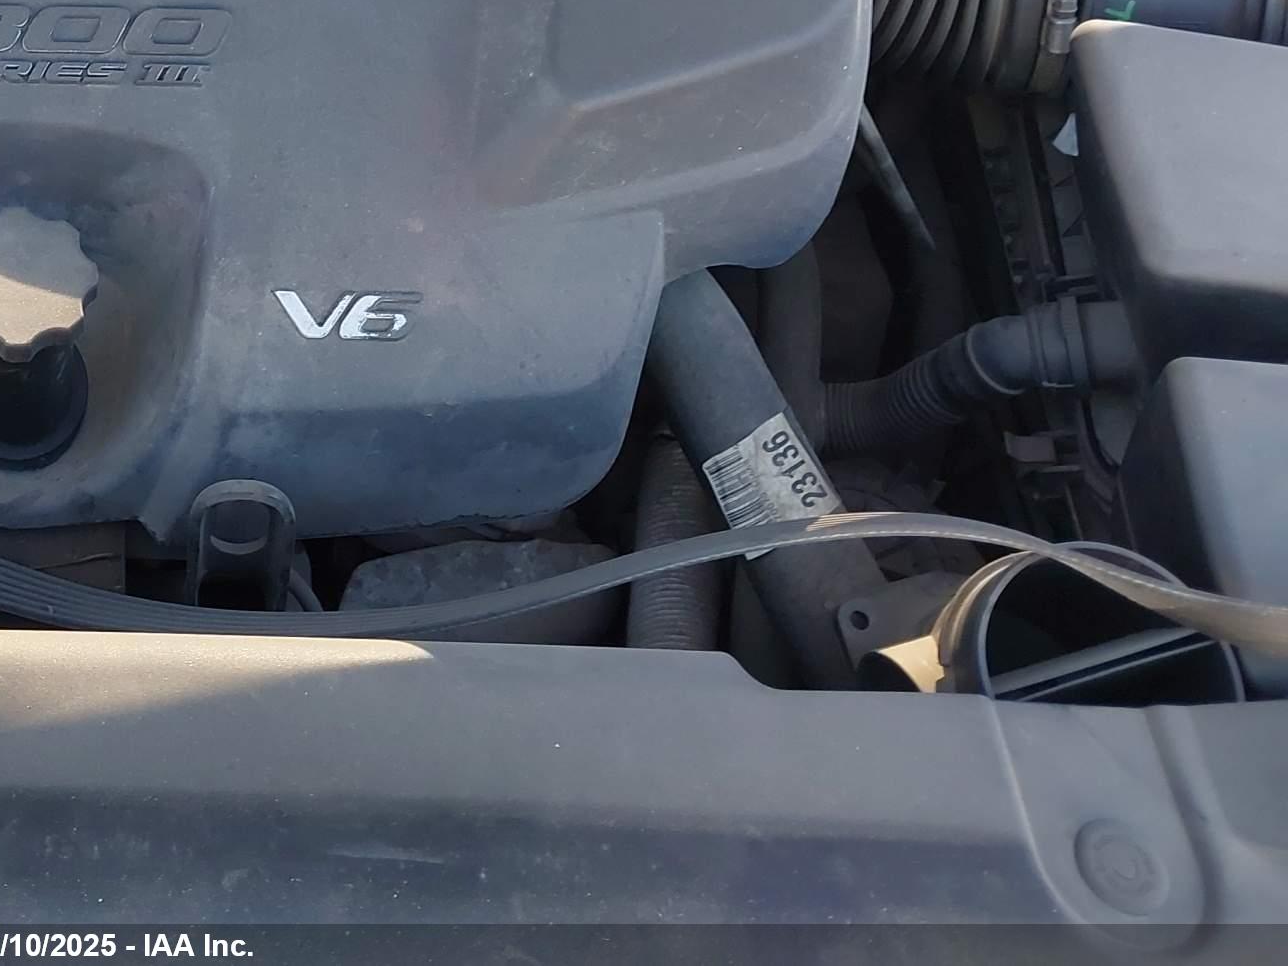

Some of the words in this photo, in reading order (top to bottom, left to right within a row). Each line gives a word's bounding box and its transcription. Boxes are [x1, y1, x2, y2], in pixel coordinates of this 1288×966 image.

[135, 62, 210, 87] III
[271, 290, 423, 341] V6
[762, 430, 828, 508] 23136
